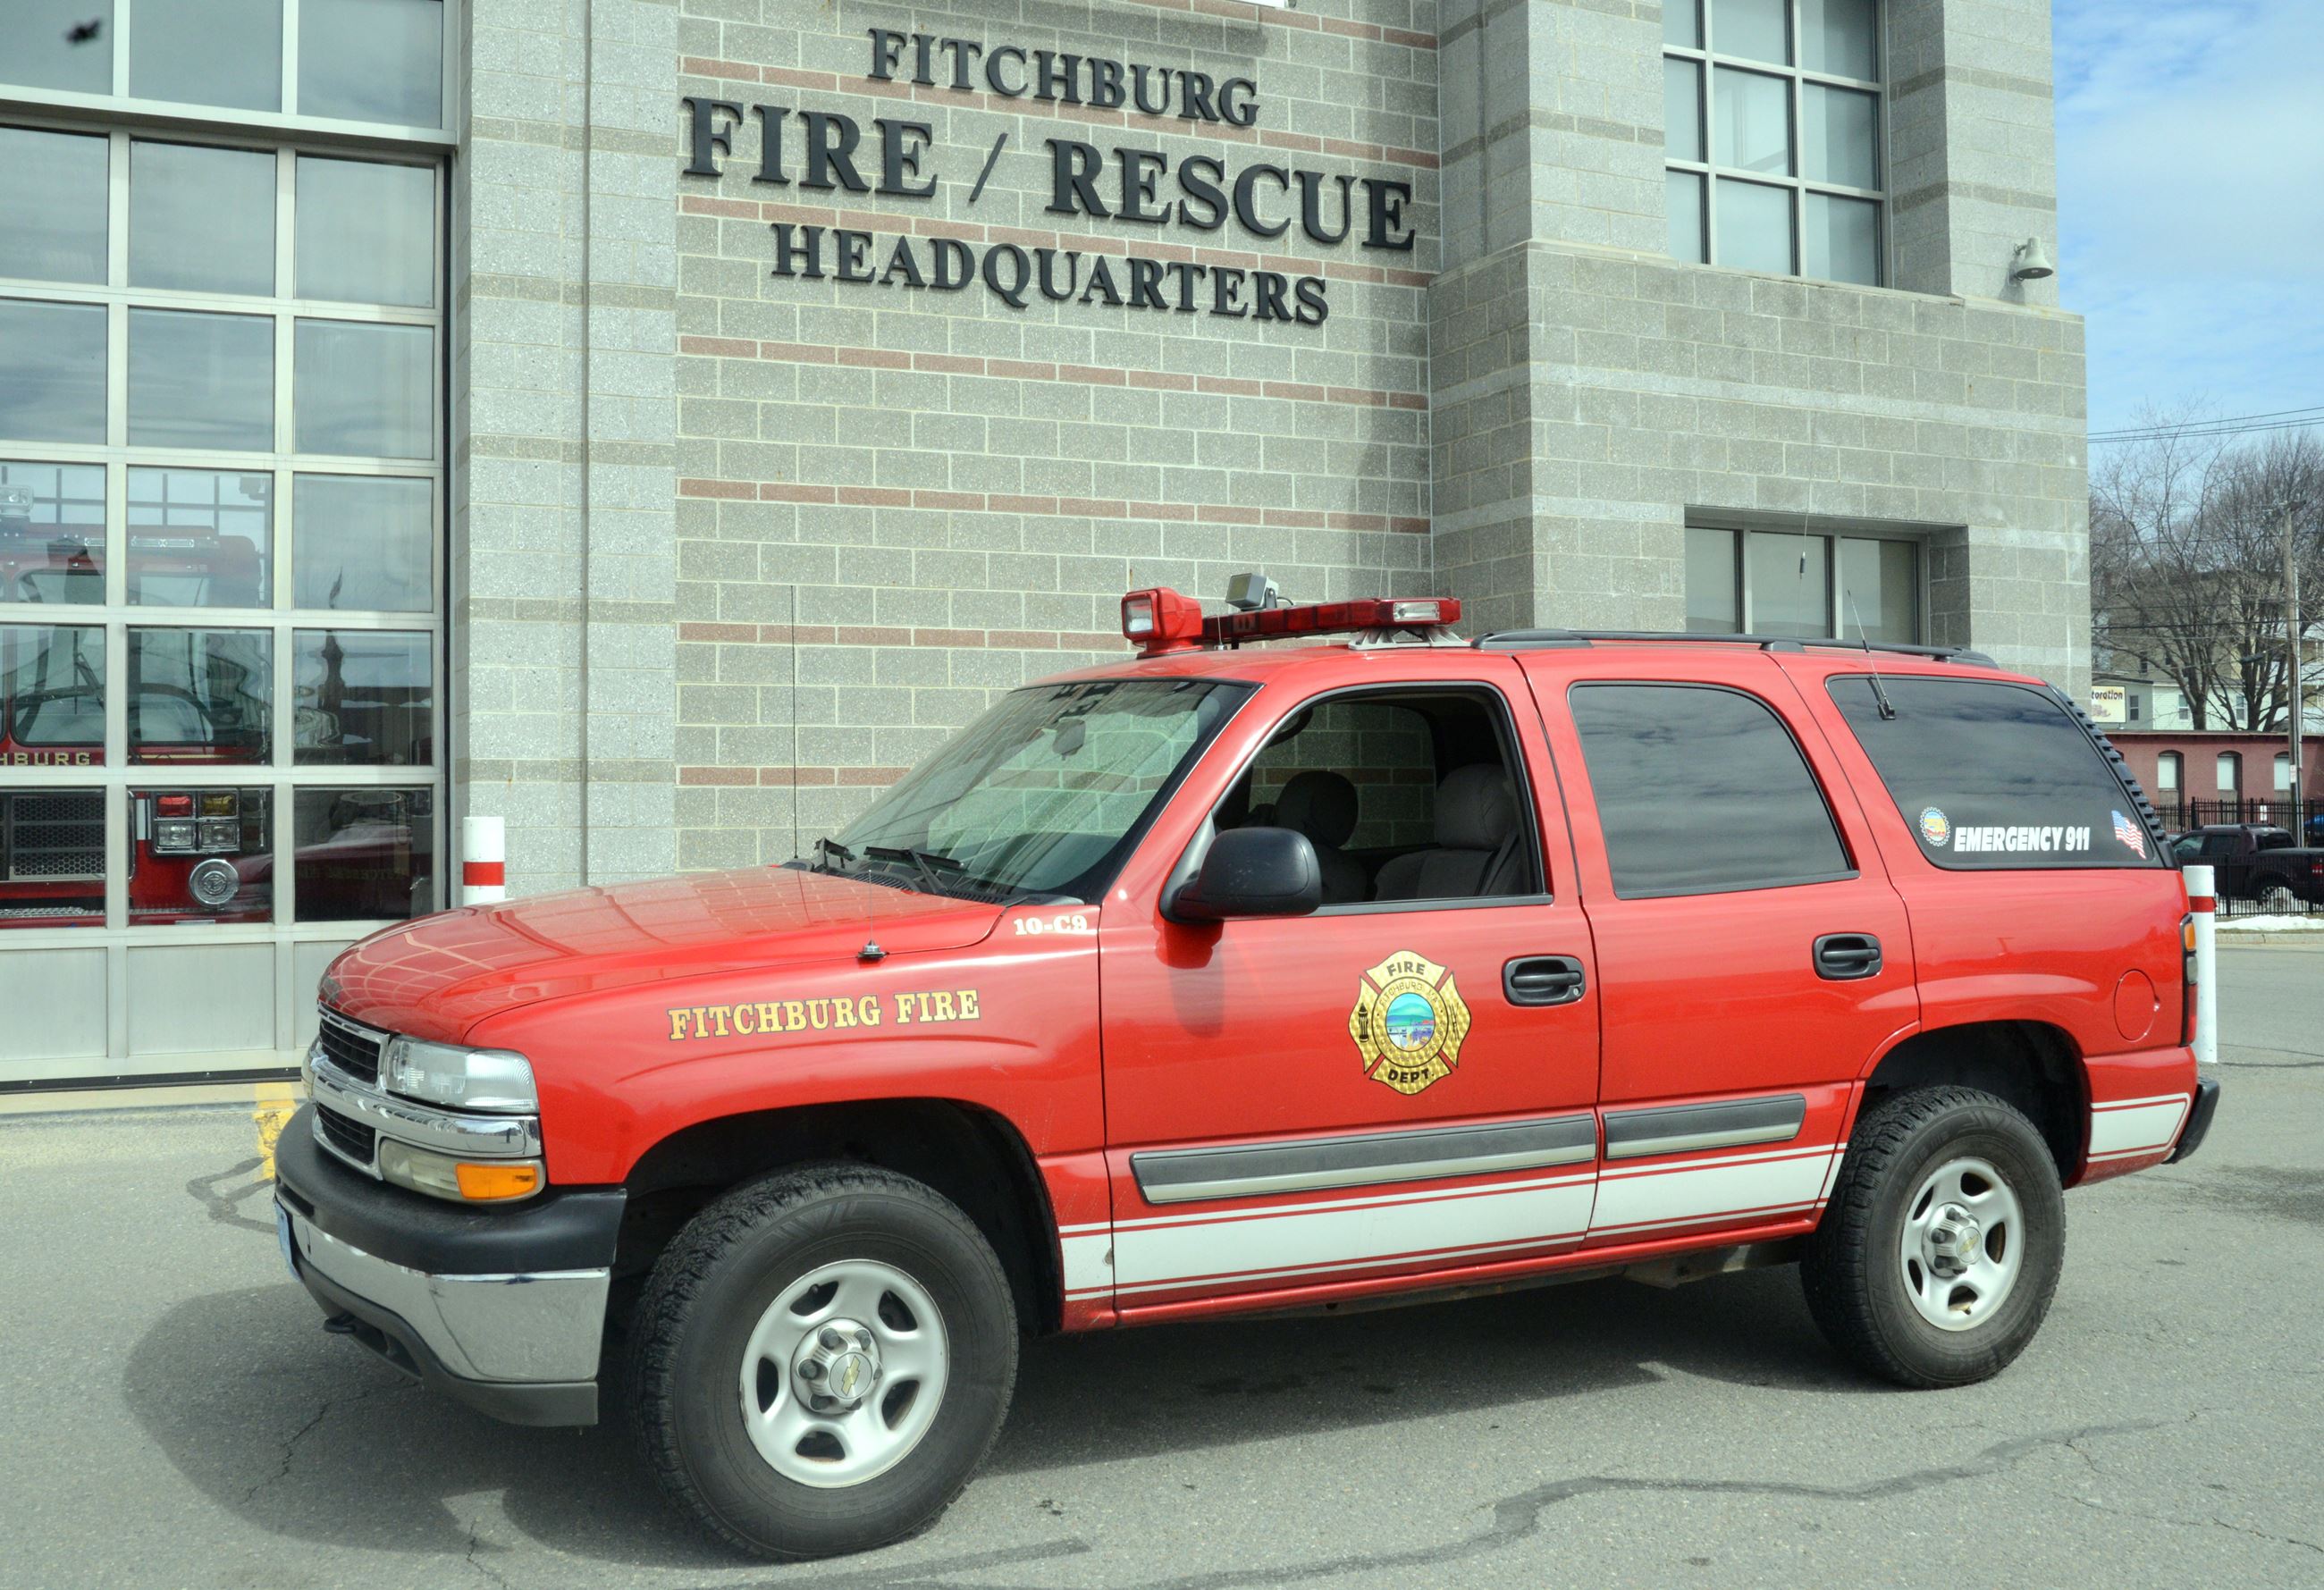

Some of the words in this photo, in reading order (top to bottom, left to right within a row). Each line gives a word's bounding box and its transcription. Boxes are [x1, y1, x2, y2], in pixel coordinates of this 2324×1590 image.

[867, 28, 1259, 127] FITCHBURG
[682, 96, 938, 198] FIRE
[968, 132, 1008, 203] /
[1045, 137, 1416, 251] RESCUE
[771, 223, 1329, 326] HEADQUARTERS
[1954, 827, 2063, 852] EMERGENCY
[2066, 827, 2091, 851] 911
[1014, 915, 1087, 935] 10-C9
[1386, 961, 1426, 977] FIRE
[668, 995, 882, 1040] FITCHBURG
[894, 988, 980, 1024] FIRE
[1388, 1069, 1435, 1083] DEPT.
